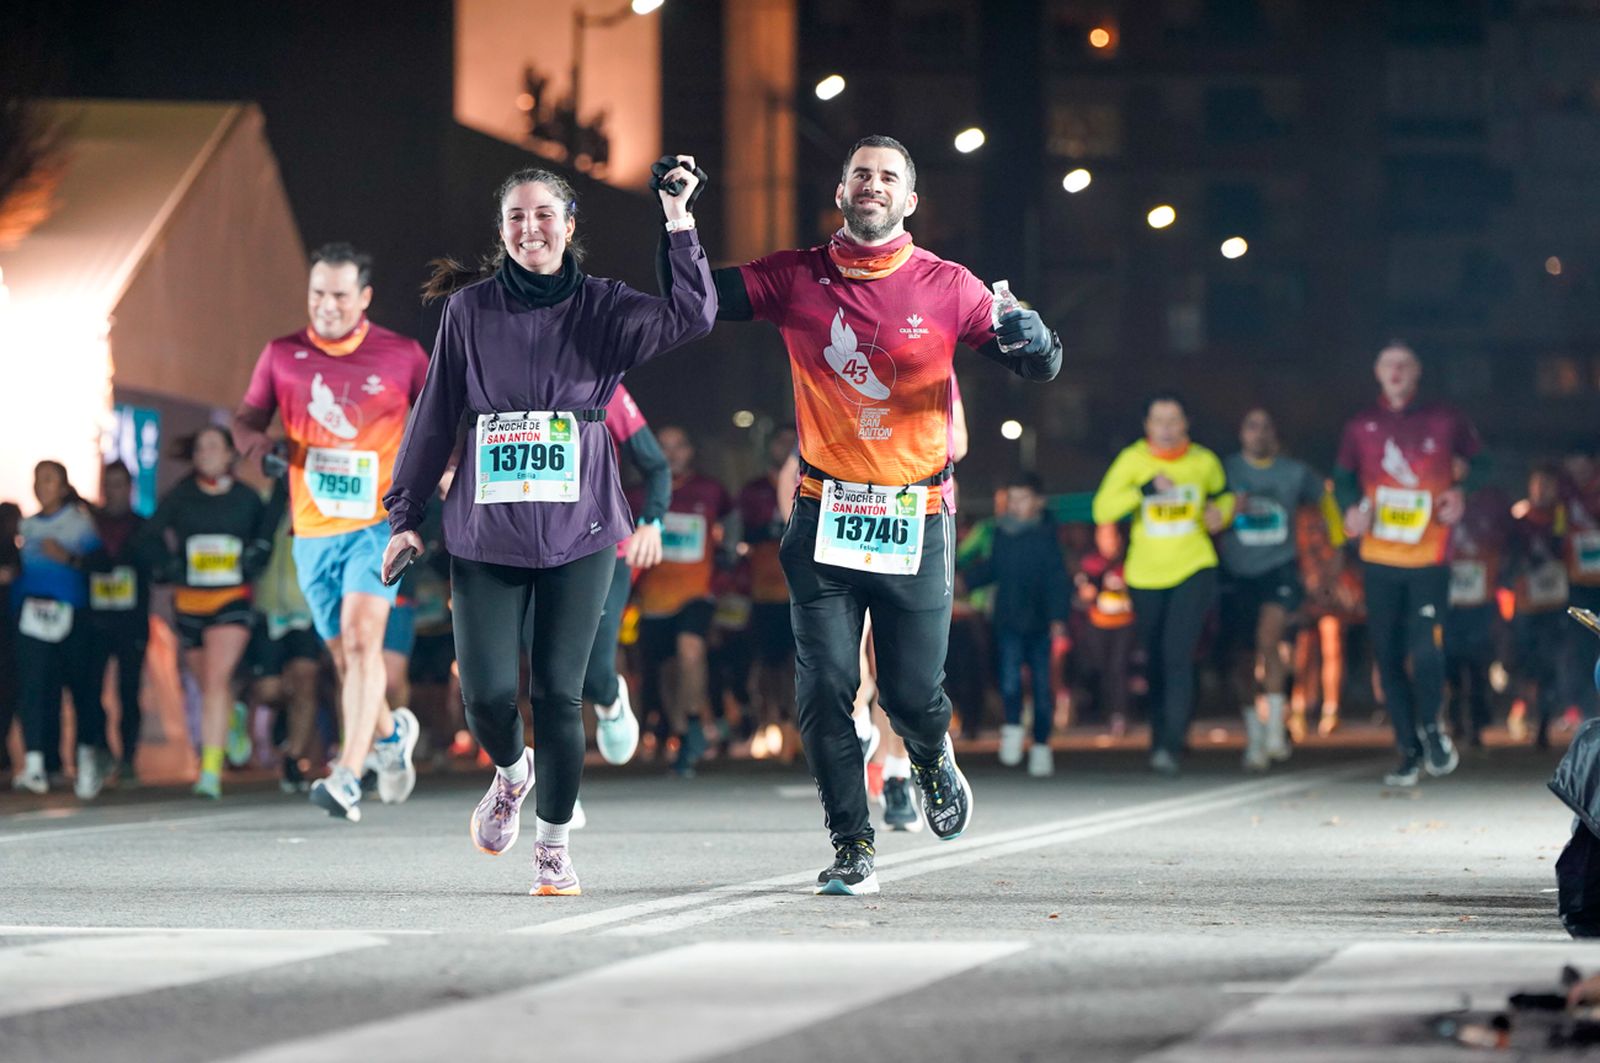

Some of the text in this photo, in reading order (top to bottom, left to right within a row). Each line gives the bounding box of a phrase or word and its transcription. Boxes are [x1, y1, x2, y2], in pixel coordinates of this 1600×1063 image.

[842, 358, 869, 385] 43
[498, 421, 527, 432] NOCHE
[528, 421, 540, 431] DE
[860, 418, 880, 428] SAN
[487, 433, 506, 445] SAN
[507, 430, 541, 443] ANTÓN
[858, 425, 892, 438] ANTÓN
[489, 443, 565, 472] 13796
[318, 472, 361, 495] 7950
[844, 494, 888, 504] NOCHE DE
[832, 502, 852, 514] SAN
[853, 504, 887, 516] ANTÓN
[834, 515, 909, 545] 13746
[859, 543, 879, 552] Felipe
